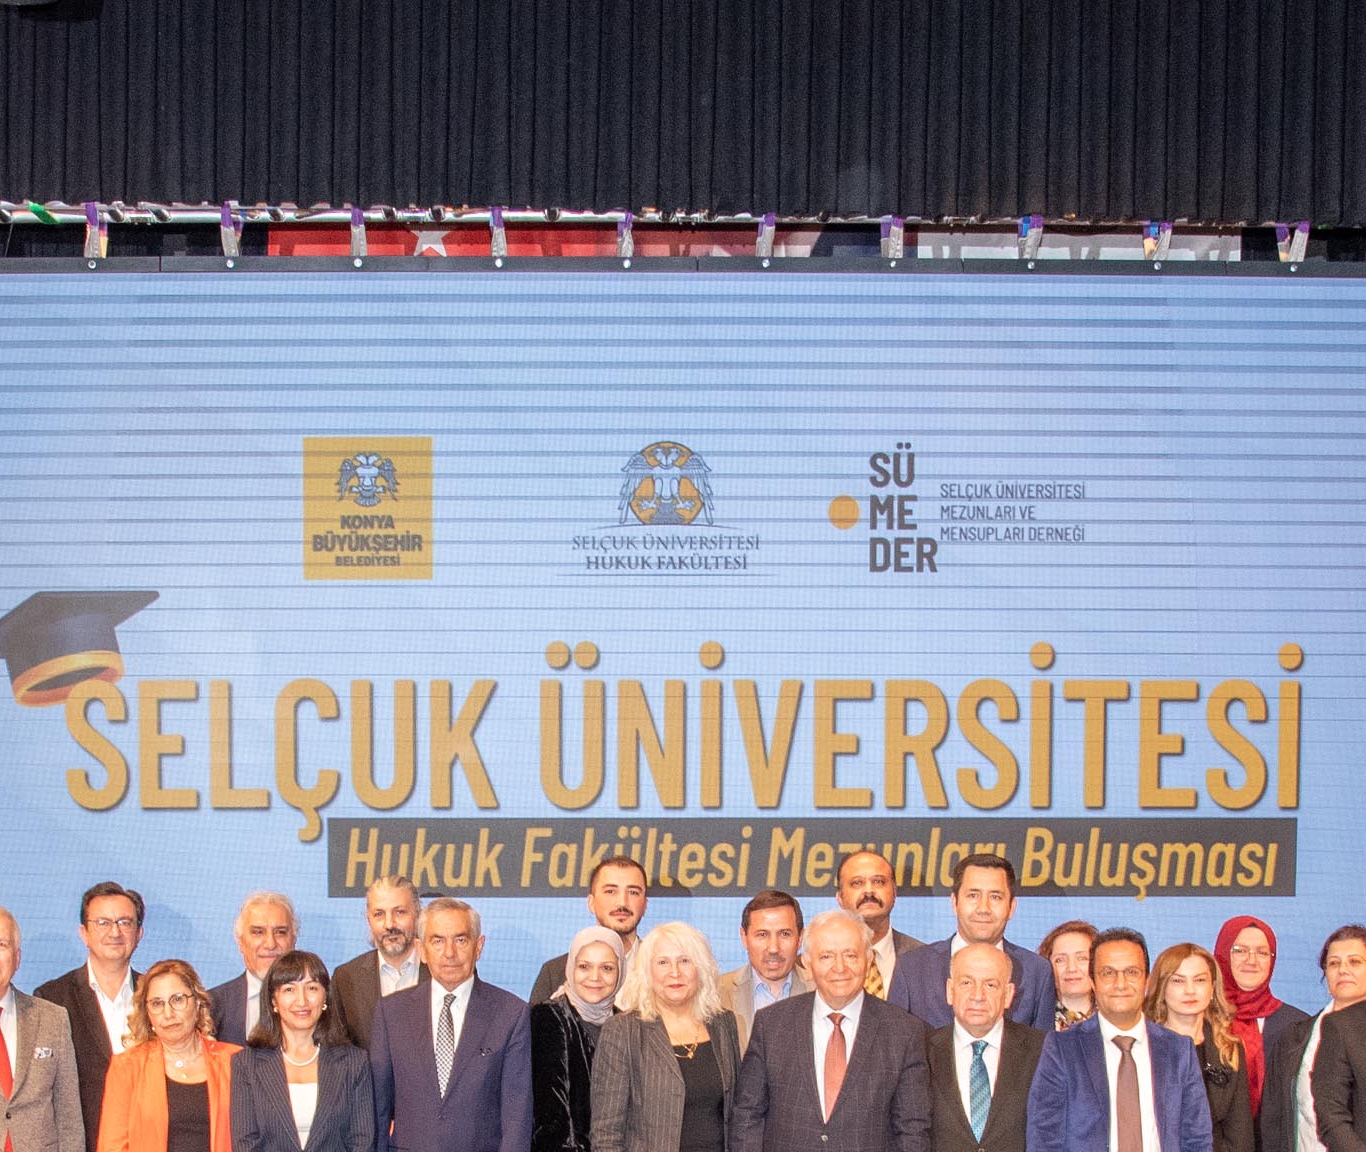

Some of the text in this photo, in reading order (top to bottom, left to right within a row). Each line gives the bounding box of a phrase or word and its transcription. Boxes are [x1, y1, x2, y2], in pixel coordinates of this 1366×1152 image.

[868, 442, 915, 488] SÜ
[940, 481, 1086, 502] SELÇUK ÜNİVERSİTESİ
[340, 514, 395, 530] KONYA
[868, 494, 919, 531] ME
[939, 505, 1036, 521] MEZUNLARI VE
[312, 530, 423, 554] BÜYÜKŞEHİR
[571, 532, 760, 554] SELÇUK ÜNİVERSİTESİ
[939, 526, 1025, 542] MENSUPLARI
[334, 554, 402, 567] BELEDİYESİ
[585, 552, 749, 571] HUKUK FAKÜLTESİ
[868, 537, 939, 573] DER
[65, 640, 1304, 843] SELÇUK ÜNİVERSİTESİ
[345, 826, 505, 889] Hukuk
[1021, 826, 1279, 901] Buluşması
